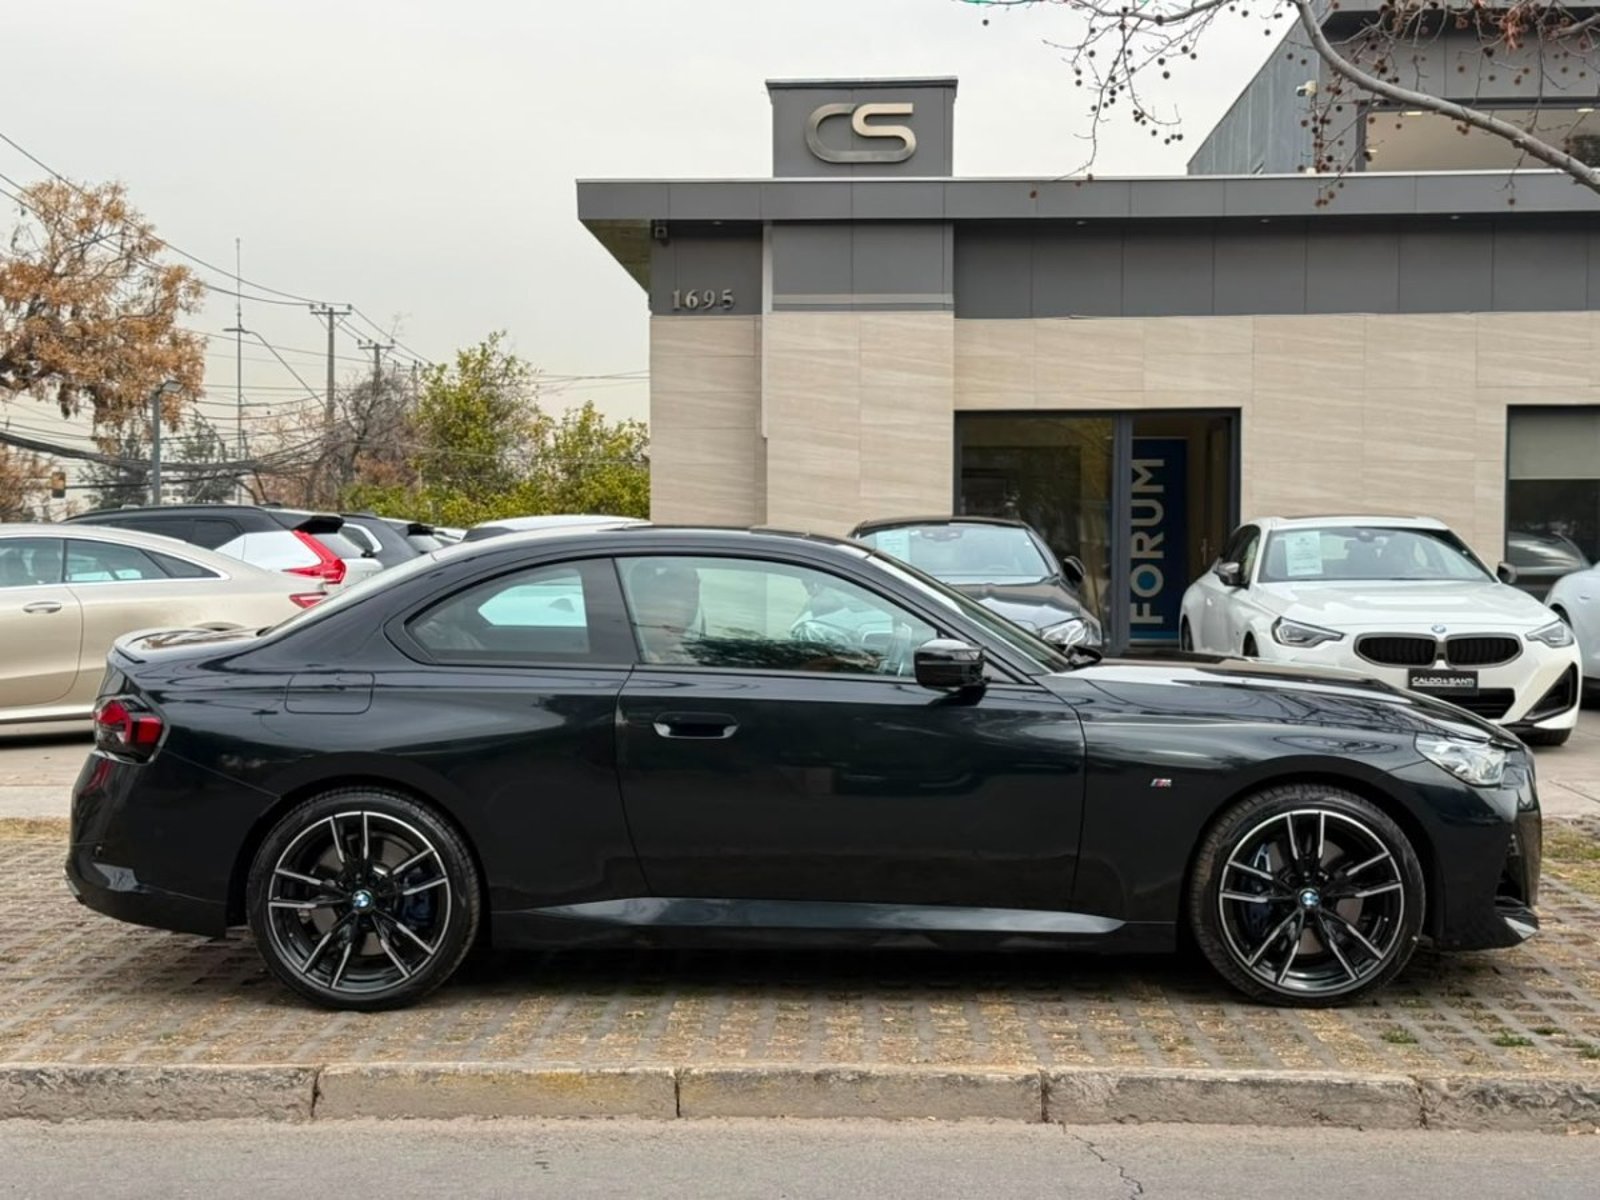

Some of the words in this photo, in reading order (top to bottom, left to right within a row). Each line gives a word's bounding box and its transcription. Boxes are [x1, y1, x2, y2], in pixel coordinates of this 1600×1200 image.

[806, 103, 917, 163] CS
[672, 288, 734, 310] 1695
[1131, 459, 1164, 624] FORUM
